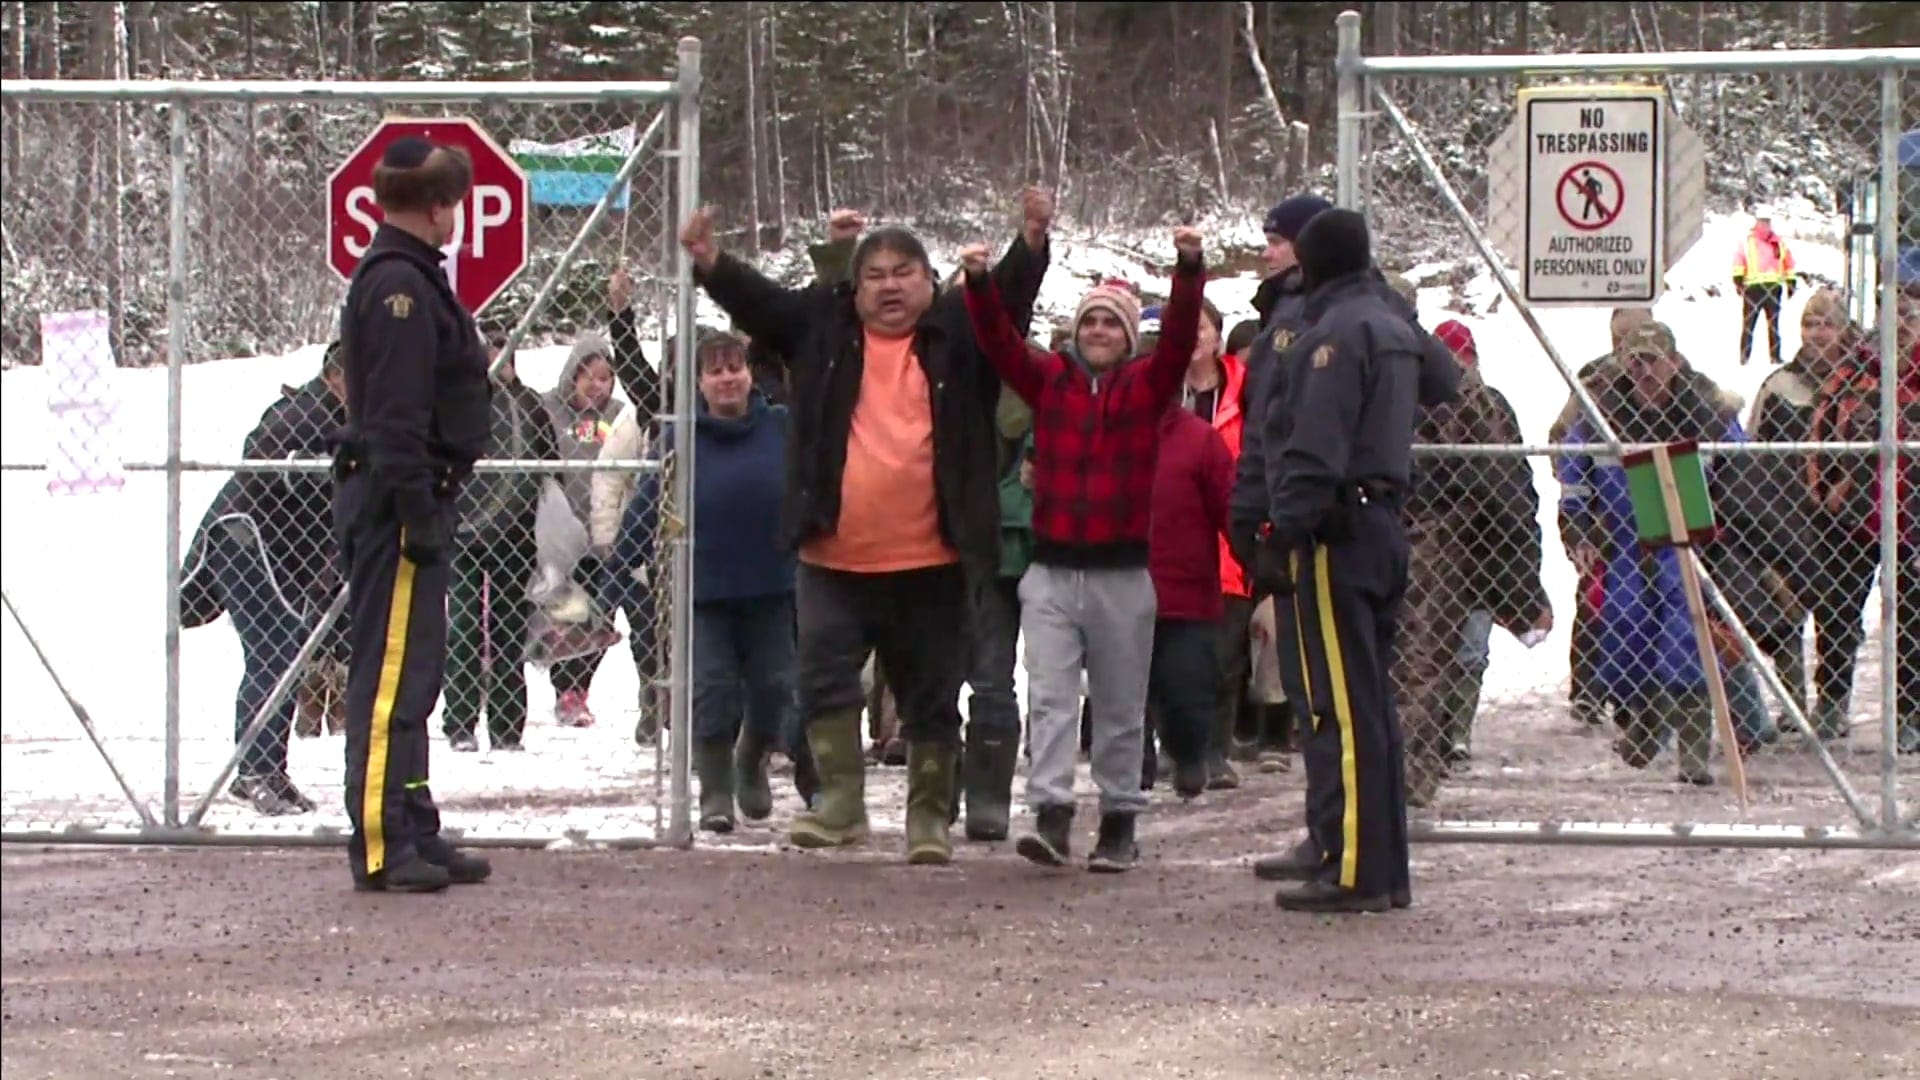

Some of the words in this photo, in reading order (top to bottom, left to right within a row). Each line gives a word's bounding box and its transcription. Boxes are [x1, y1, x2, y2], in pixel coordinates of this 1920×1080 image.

[1580, 108, 1604, 129] NO
[1536, 133, 1648, 154] TRESPASSING
[343, 185, 512, 258] SP
[1548, 236, 1633, 253] AUTHORIZED
[1534, 259, 1609, 276] PERSONNEL
[1613, 258, 1647, 275] ONLY
